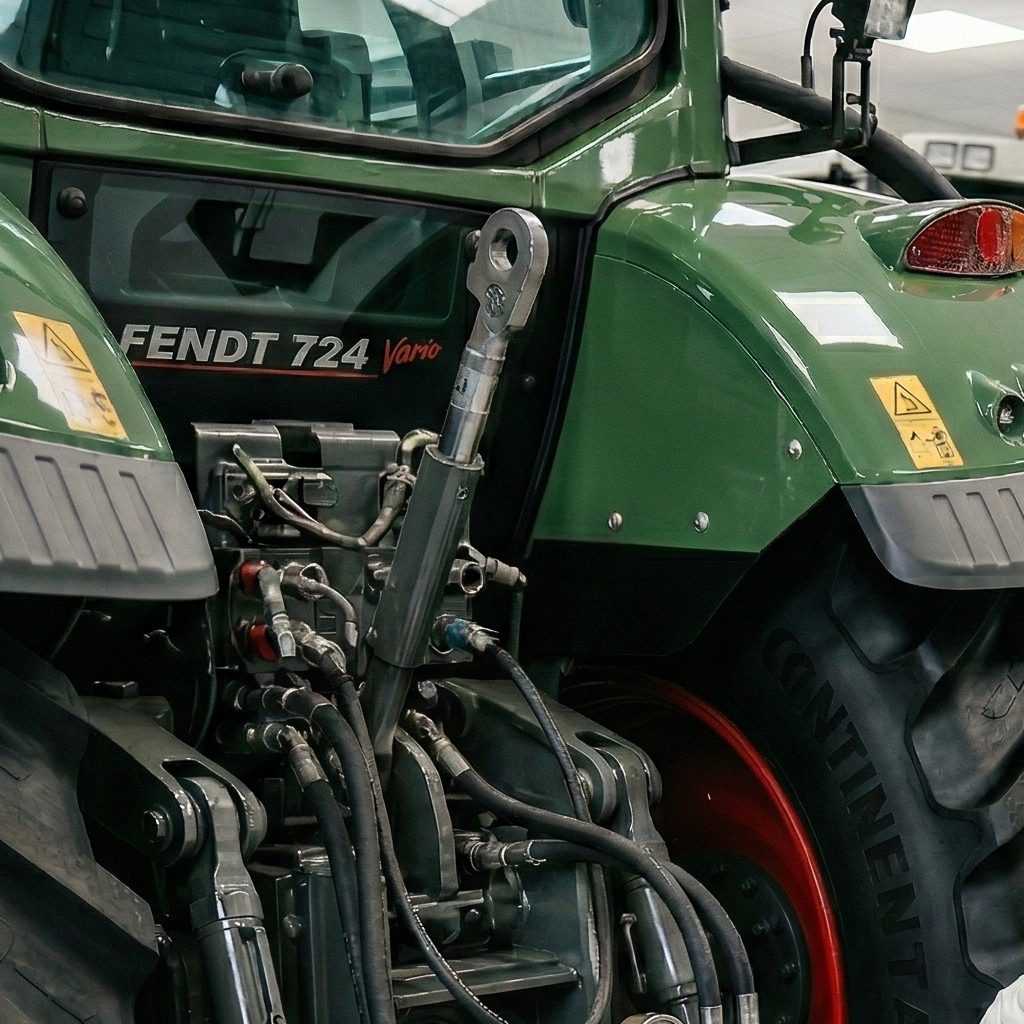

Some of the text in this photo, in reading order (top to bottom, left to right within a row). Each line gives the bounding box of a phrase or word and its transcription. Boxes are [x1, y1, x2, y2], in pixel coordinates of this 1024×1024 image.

[120, 323, 443, 374] FENDT 724 Vario
